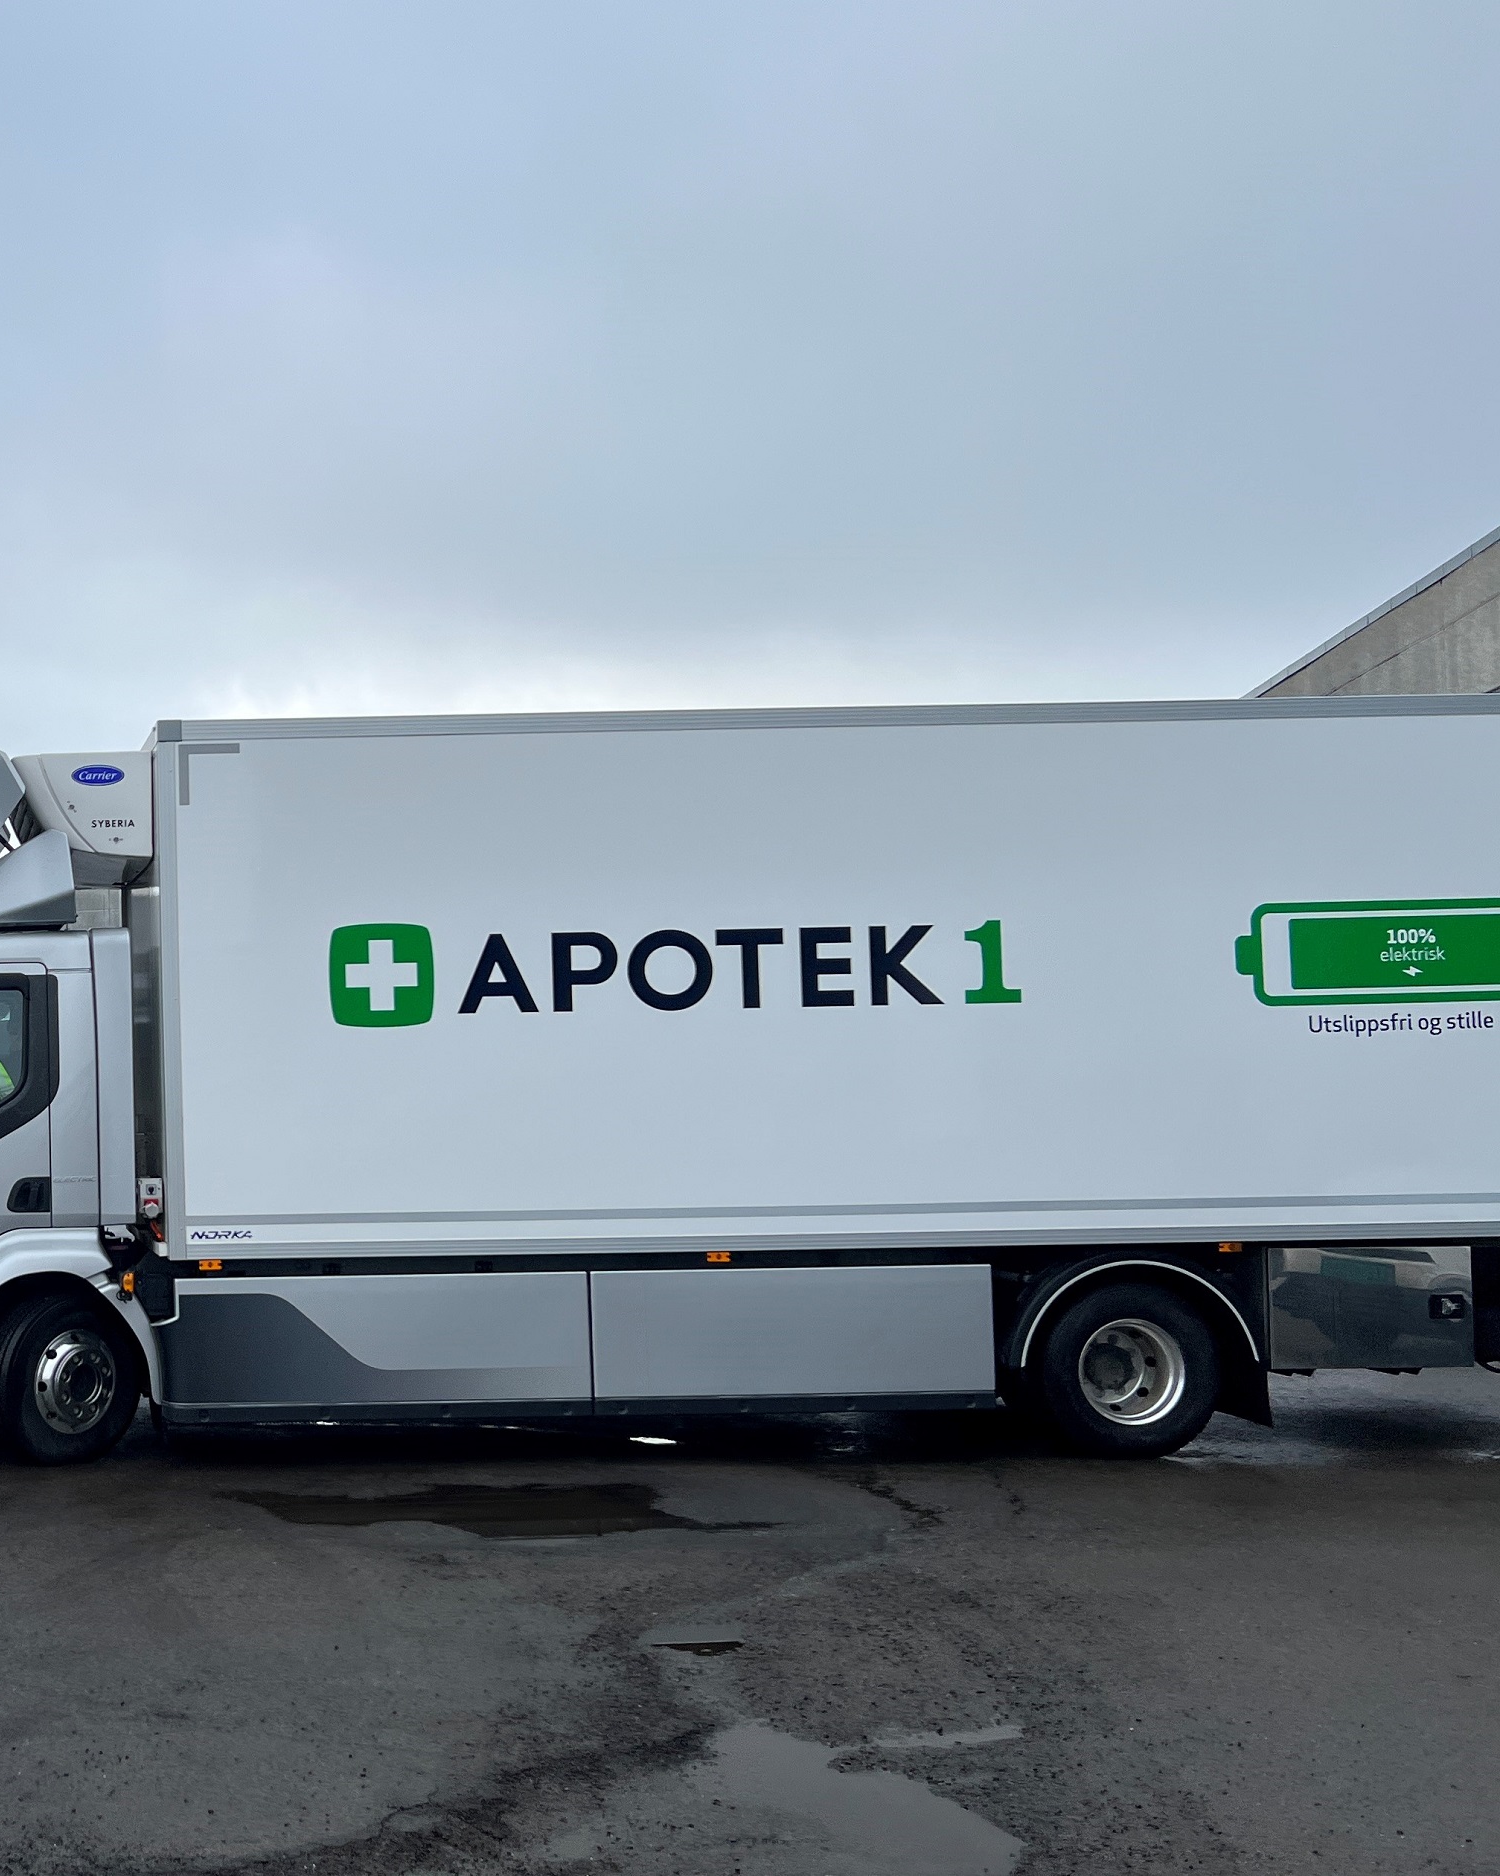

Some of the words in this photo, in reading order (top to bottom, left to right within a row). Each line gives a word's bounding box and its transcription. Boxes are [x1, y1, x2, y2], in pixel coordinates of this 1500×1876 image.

[78, 770, 118, 781] Carrier
[90, 819, 136, 829] SYBERIA
[1386, 928, 1437, 945] 100%
[1379, 945, 1447, 963] elektrisk
[457, 924, 947, 1015] APOTEK
[963, 919, 1023, 1004] 1
[1308, 1012, 1414, 1038] Utslippsfri
[1418, 1016, 1443, 1036] og
[1446, 1010, 1495, 1030] stille
[190, 1230, 254, 1240] NORKA
